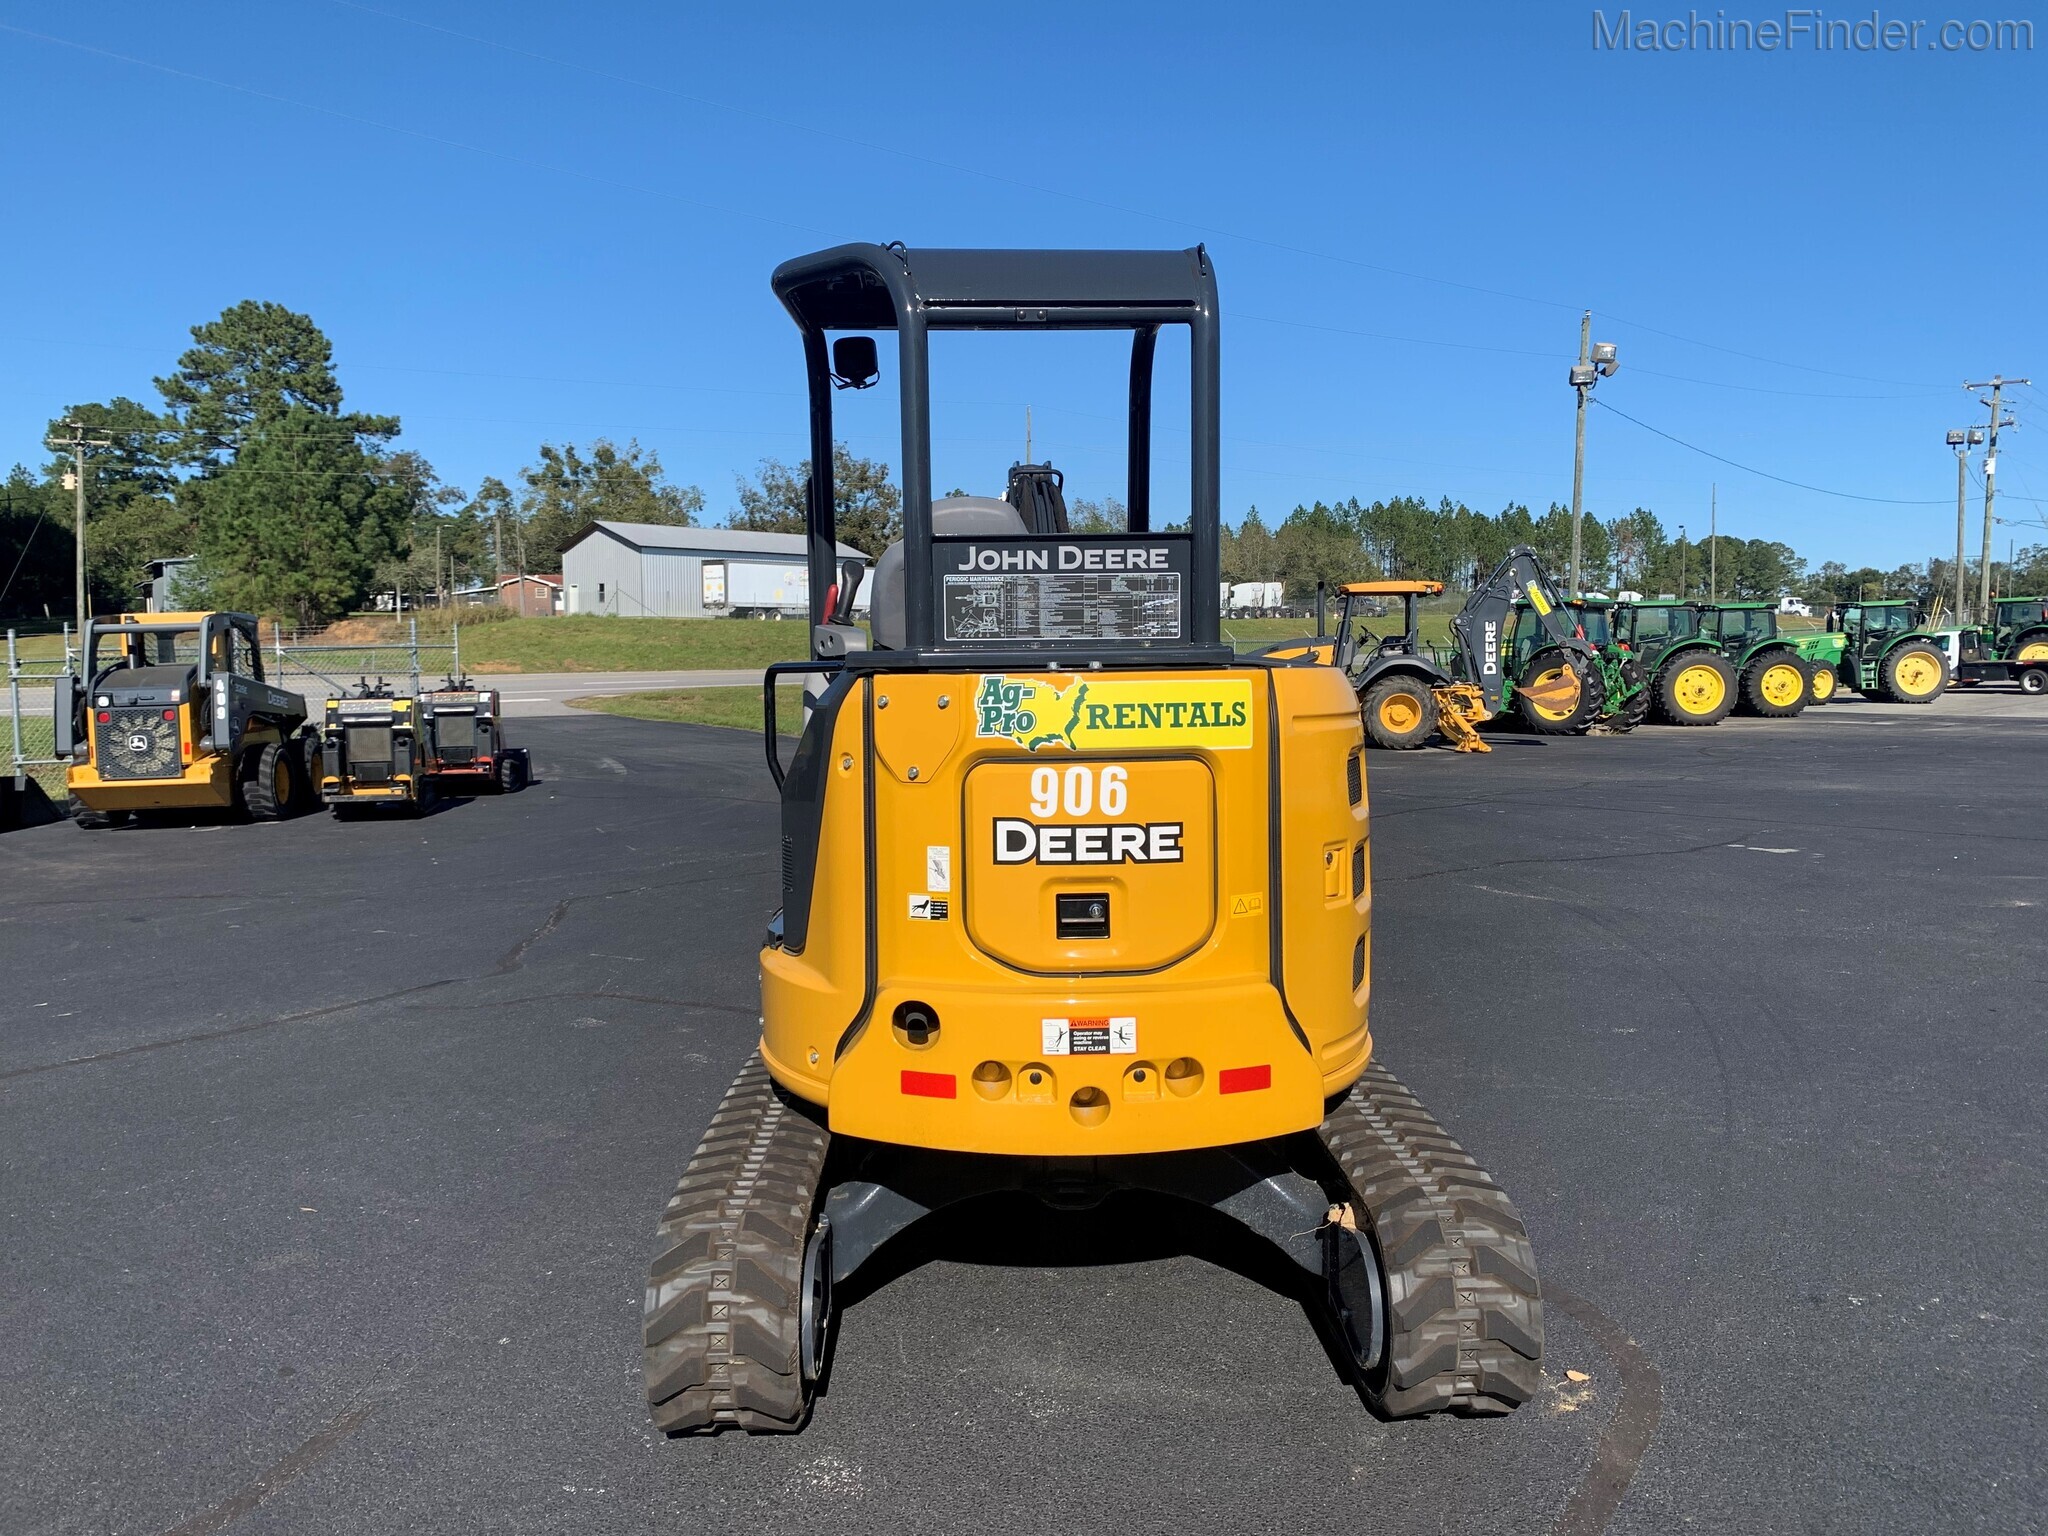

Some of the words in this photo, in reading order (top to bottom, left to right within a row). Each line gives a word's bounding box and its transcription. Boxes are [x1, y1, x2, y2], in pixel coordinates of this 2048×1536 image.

[958, 546, 1048, 571] JOHN
[1058, 545, 1169, 570] DEERE
[1483, 621, 1497, 675] DEERE
[216, 679, 226, 720] 409
[268, 690, 289, 708] DEERE
[980, 676, 1035, 710] Ag-
[979, 705, 1036, 735] Pro
[1086, 701, 1247, 730] RENTALS
[1030, 766, 1128, 817] 906
[994, 818, 1183, 864] DEERE
